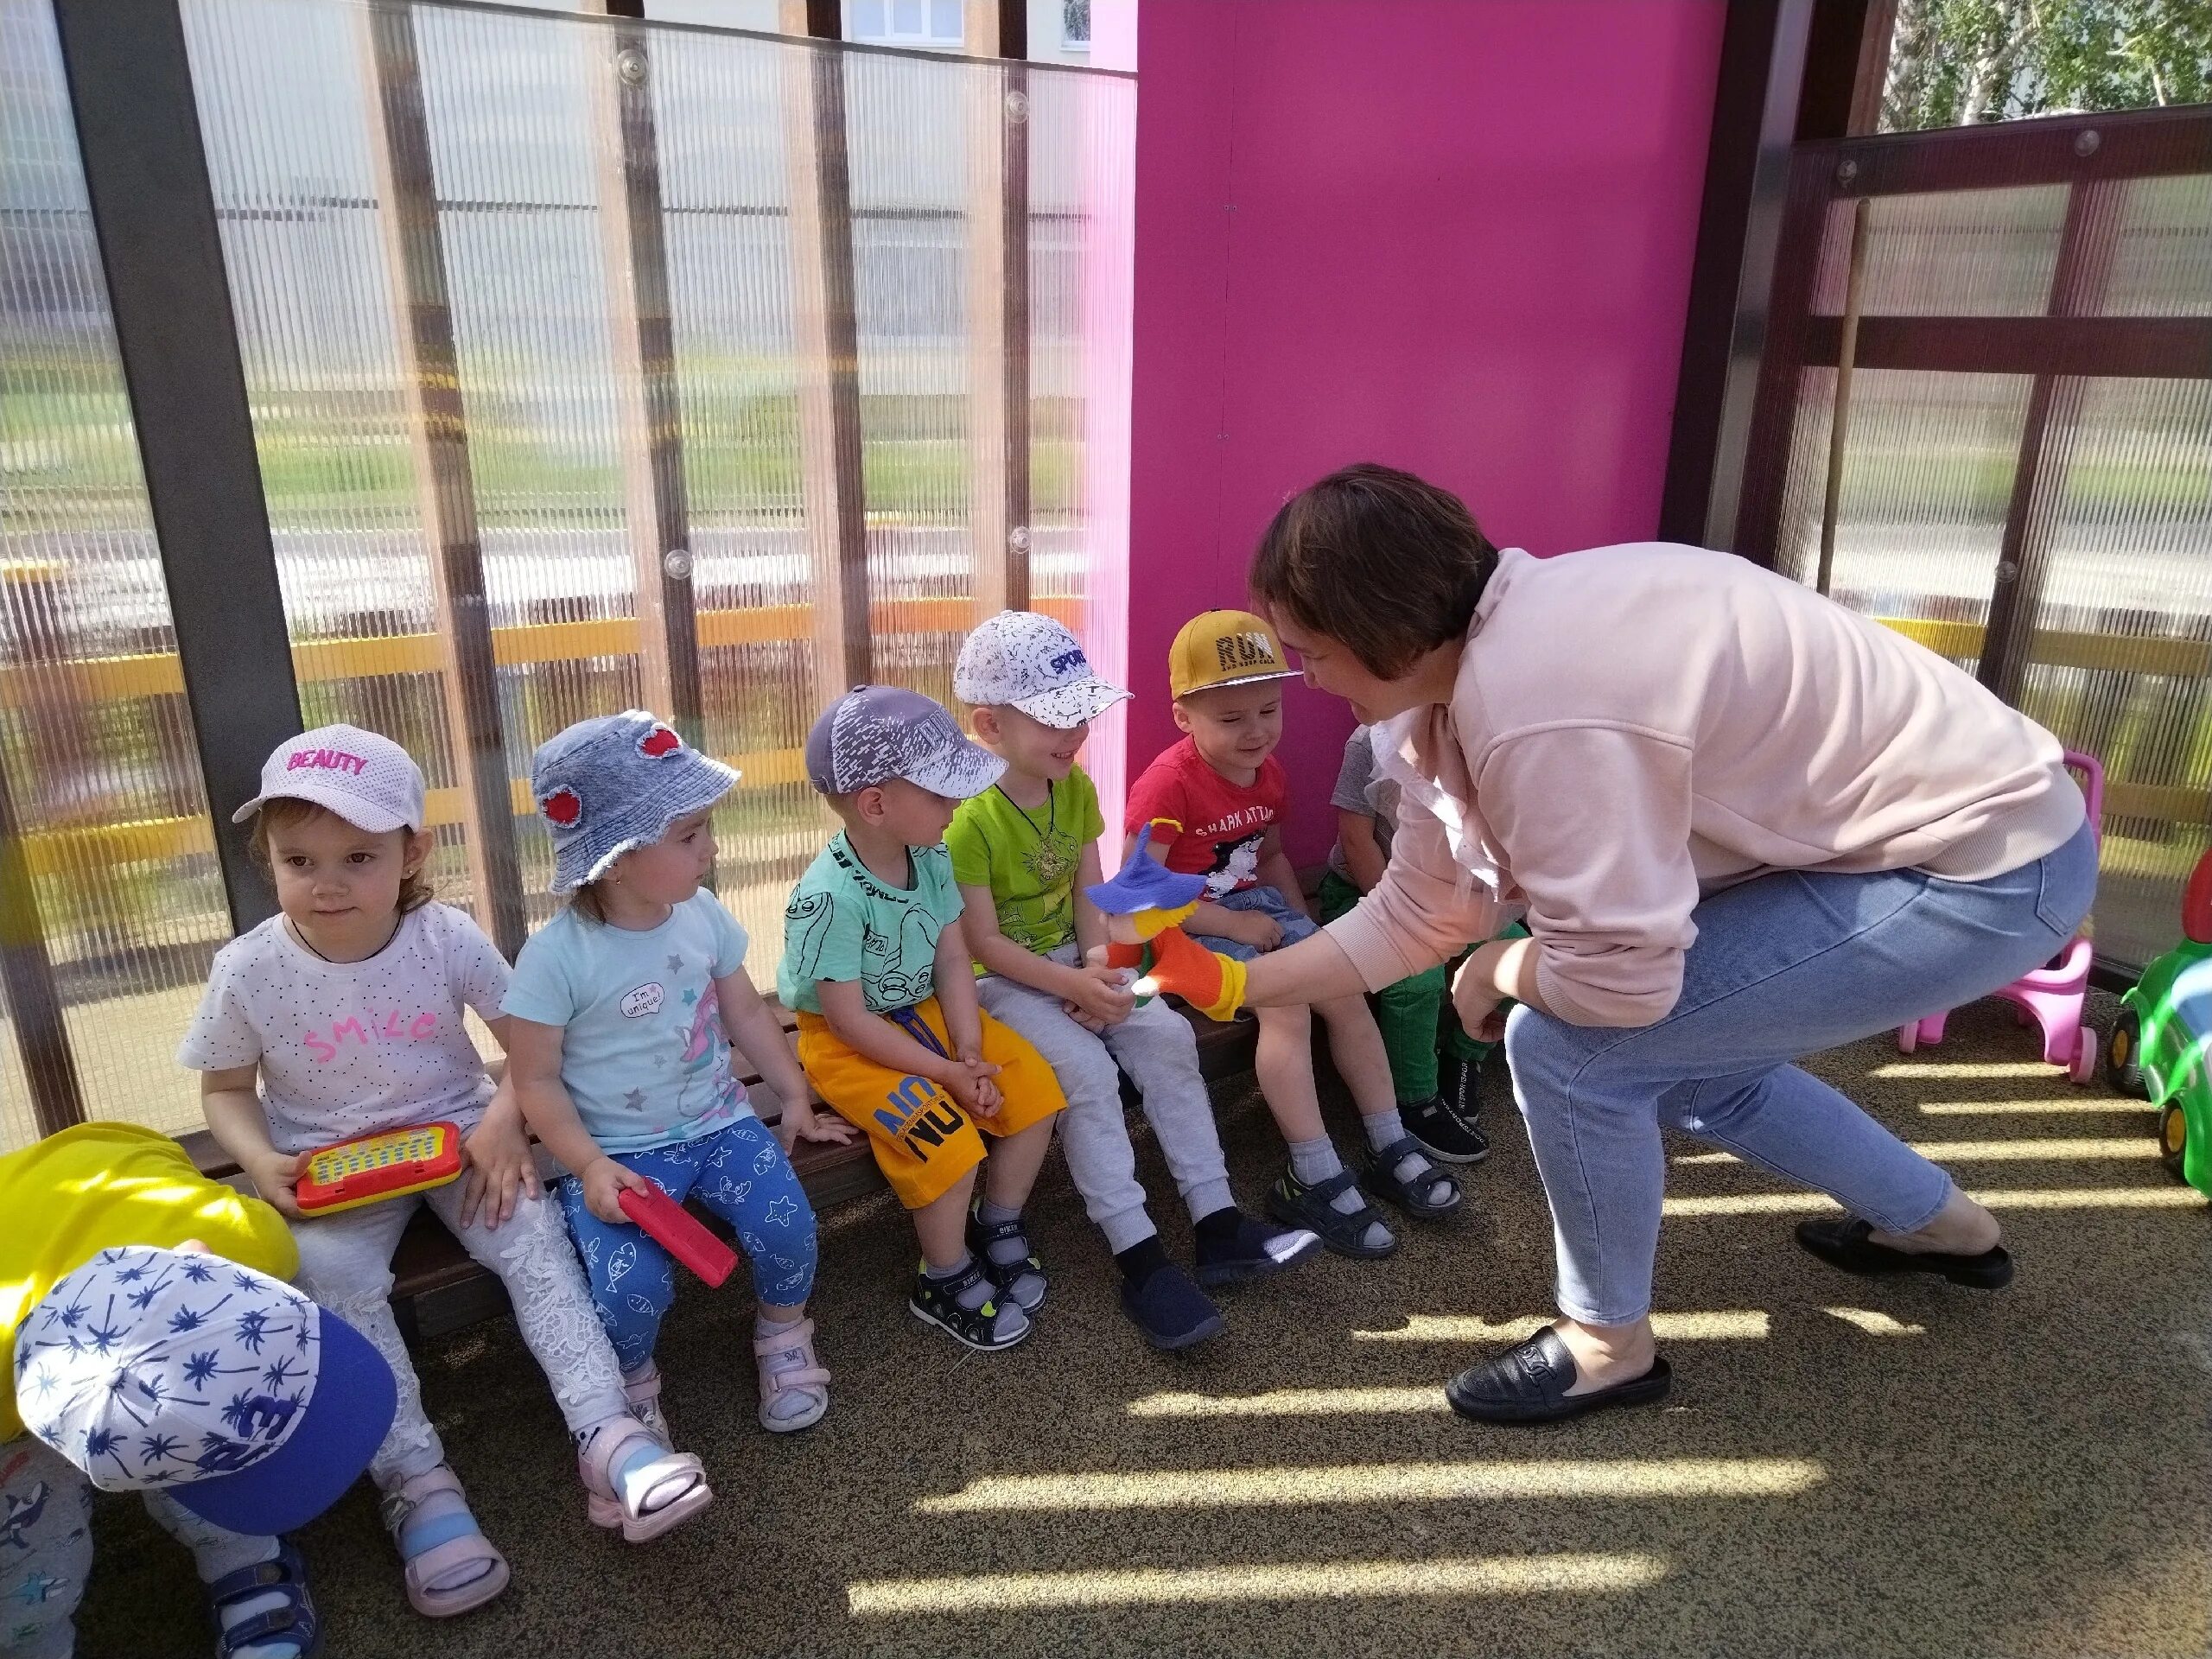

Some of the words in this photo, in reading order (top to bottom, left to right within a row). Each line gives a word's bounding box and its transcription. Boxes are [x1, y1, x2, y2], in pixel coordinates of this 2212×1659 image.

[1215, 632, 1274, 666] RUN
[286, 748, 368, 775] BEAUTY
[1195, 810, 1243, 836] SHARK
[627, 990, 661, 1015] unique!
[632, 991, 649, 1002] I'm
